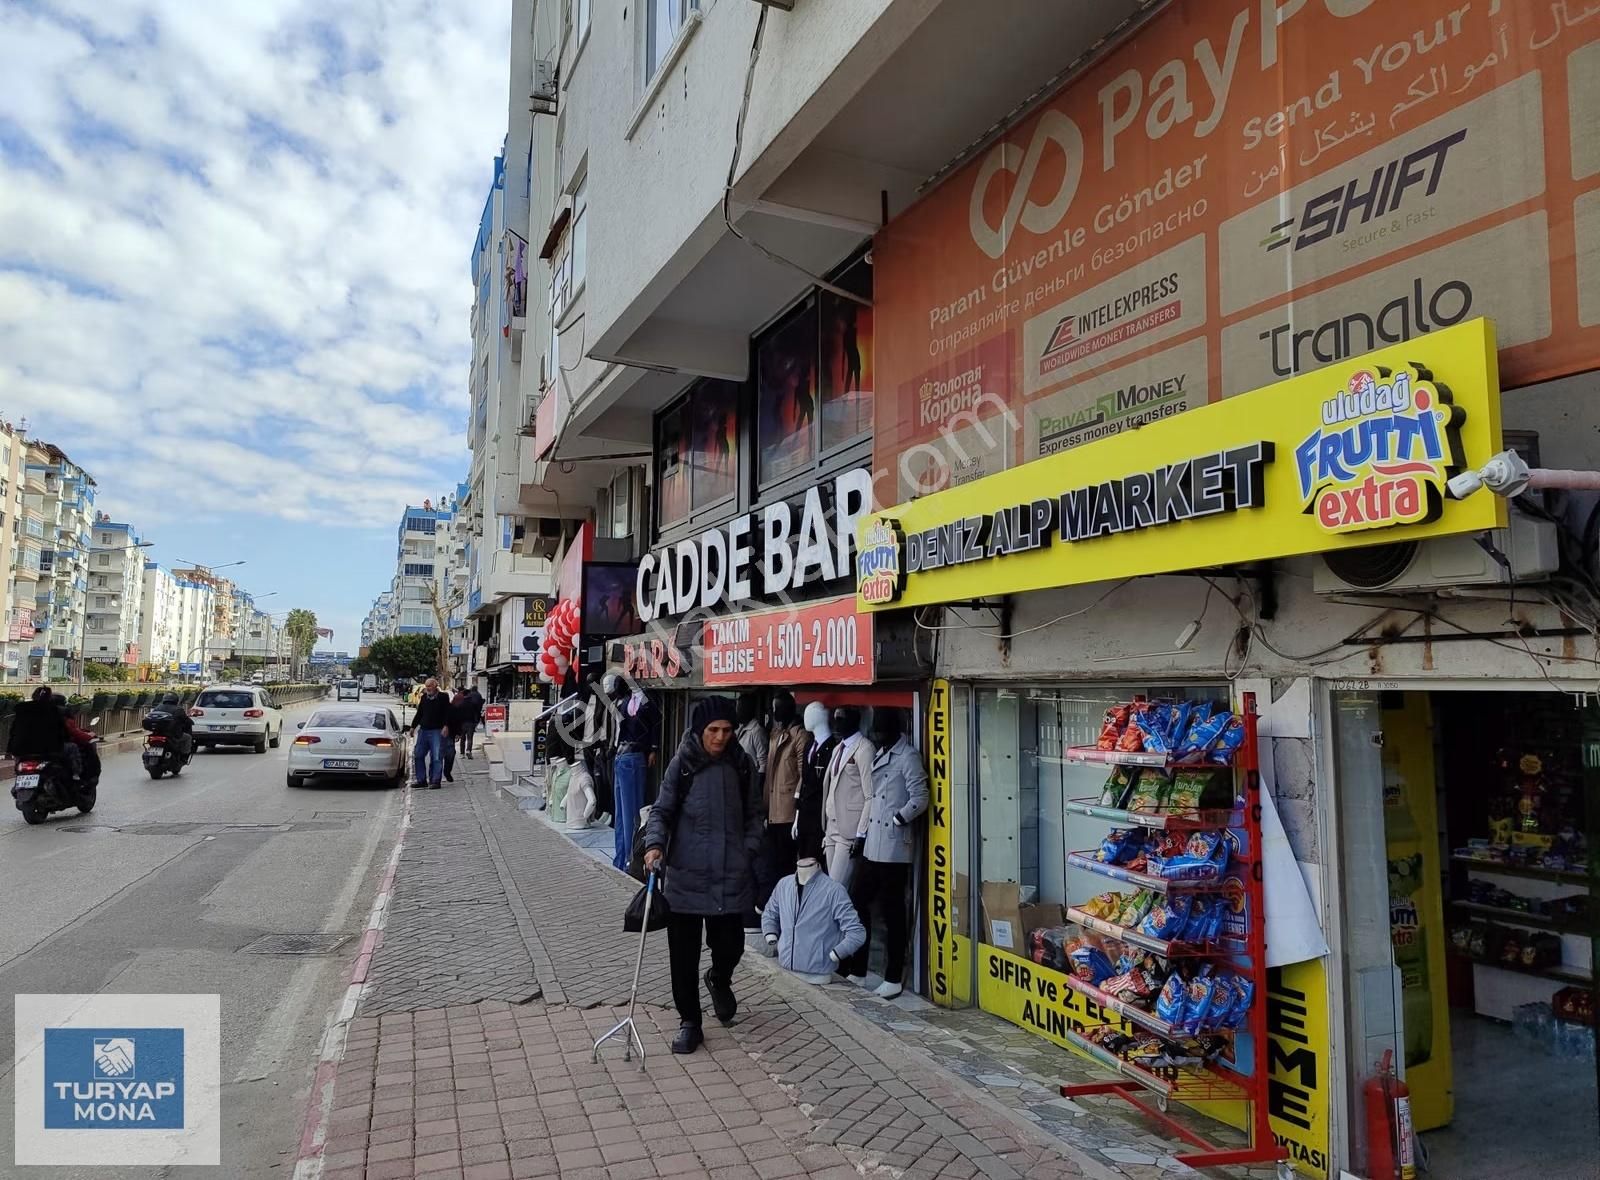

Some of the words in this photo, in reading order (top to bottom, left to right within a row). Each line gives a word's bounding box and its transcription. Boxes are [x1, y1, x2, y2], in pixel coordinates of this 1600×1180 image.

[1242, 71, 1342, 150] send
[1353, 4, 1471, 84] Your
[1294, 128, 1468, 252] SHIFT
[929, 287, 986, 330] Paranı
[991, 226, 1086, 293] Güvenle
[1093, 153, 1208, 234] Gönder
[1342, 225, 1387, 253] Secure
[1405, 207, 1436, 228] Fast
[929, 298, 1020, 357] Отправляйте
[1023, 263, 1085, 311] деньги
[1091, 198, 1208, 271] безопасно
[1078, 272, 1179, 336] INTELEXPRESS
[1042, 344, 1091, 371] WORLDWIDE
[1091, 329, 1124, 355] MONEY
[1125, 306, 1176, 334] TRANSFERS
[920, 382, 982, 427] Корона
[933, 364, 983, 397] Золотая
[1322, 371, 1411, 425] uludağ
[1039, 433, 1081, 456] Express
[1083, 422, 1123, 443] money
[1125, 401, 1187, 428] transfers
[987, 498, 1053, 557] ALP
[1060, 443, 1264, 543] MARKET
[1320, 476, 1419, 527] extra
[636, 514, 751, 622] CADDE
[764, 468, 872, 594] BAR
[863, 577, 890, 600] extra
[624, 631, 681, 679] PARS
[711, 646, 755, 674] ELBİSE
[989, 955, 1032, 992] SIFIR
[1037, 977, 1057, 1002] ve
